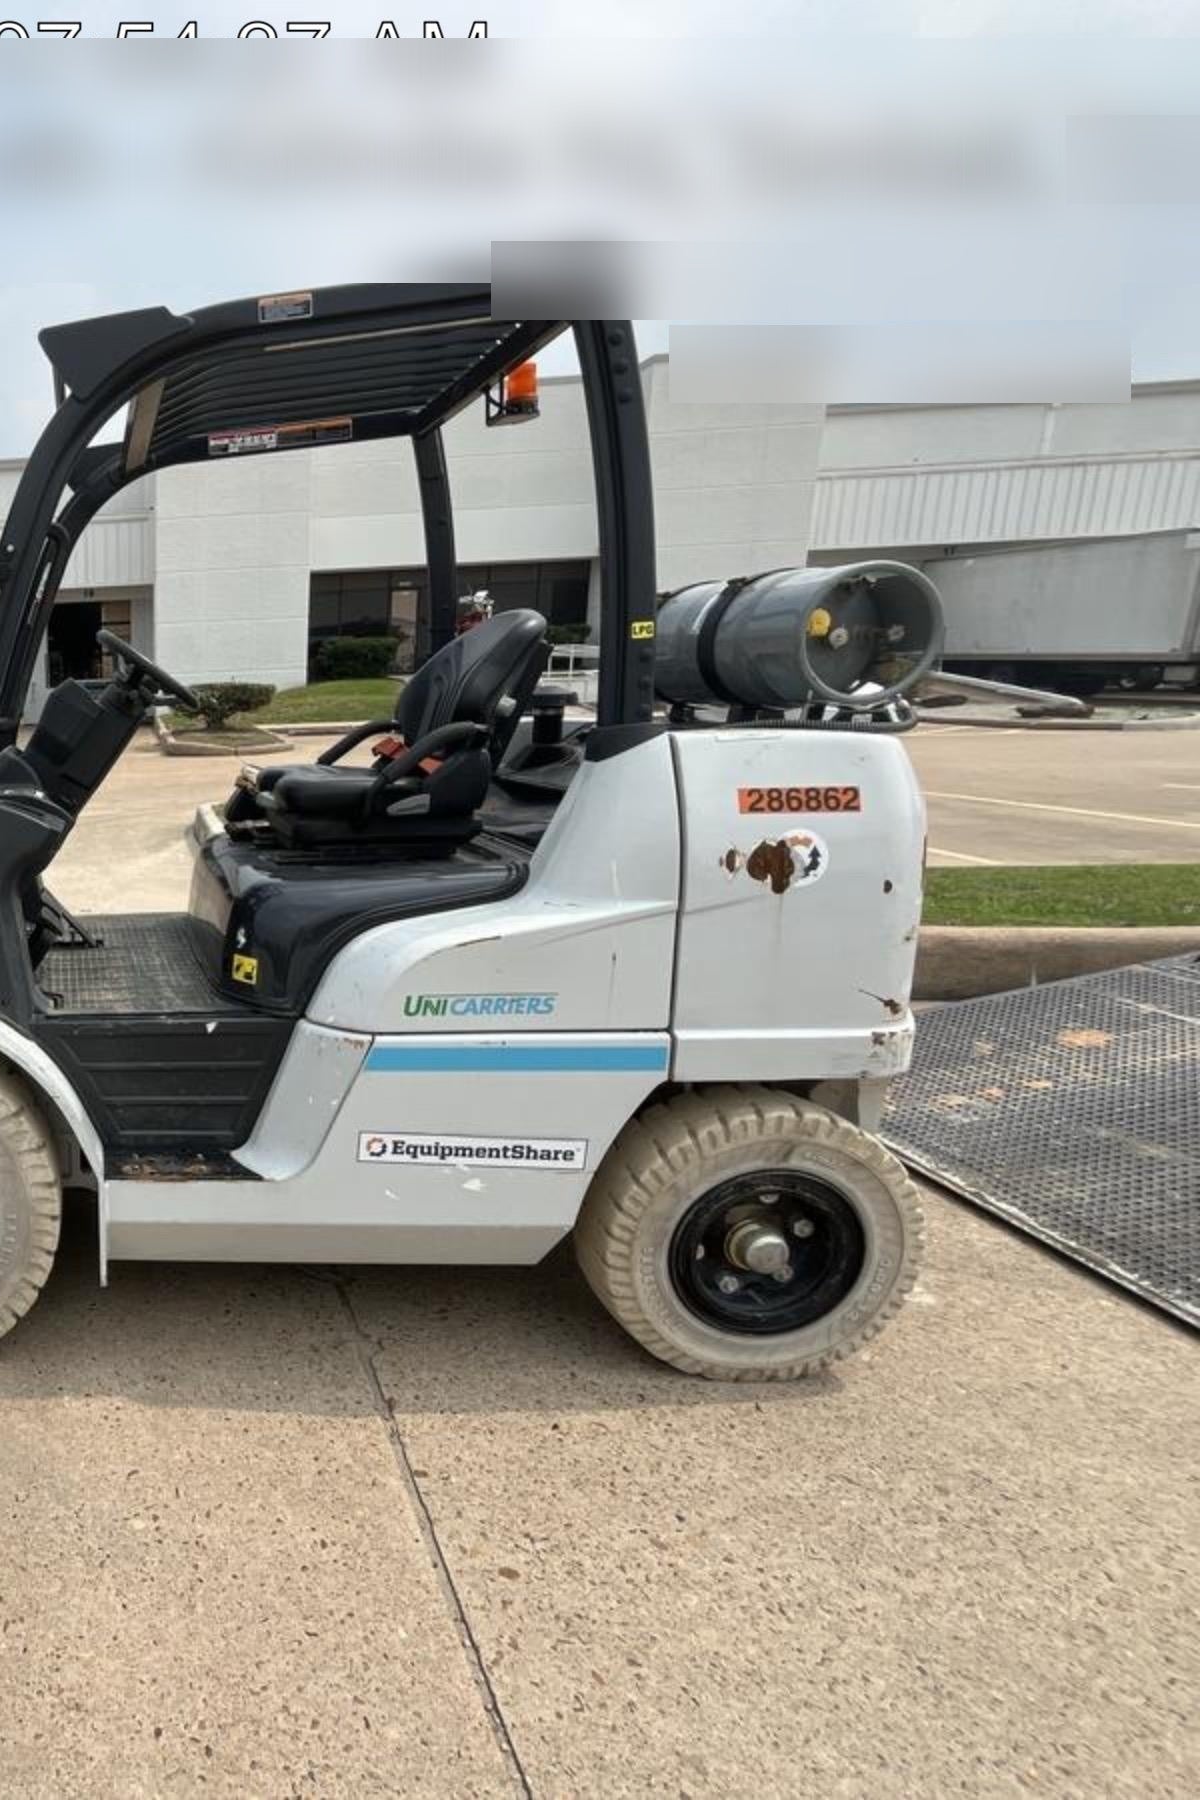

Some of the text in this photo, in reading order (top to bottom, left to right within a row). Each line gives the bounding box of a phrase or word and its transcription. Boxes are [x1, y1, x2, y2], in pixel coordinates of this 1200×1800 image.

[633, 625, 653, 635] LPG
[746, 786, 861, 812] 286862
[403, 995, 557, 1017] UNICARRIERS
[391, 1139, 576, 1162] EquipmentShare
